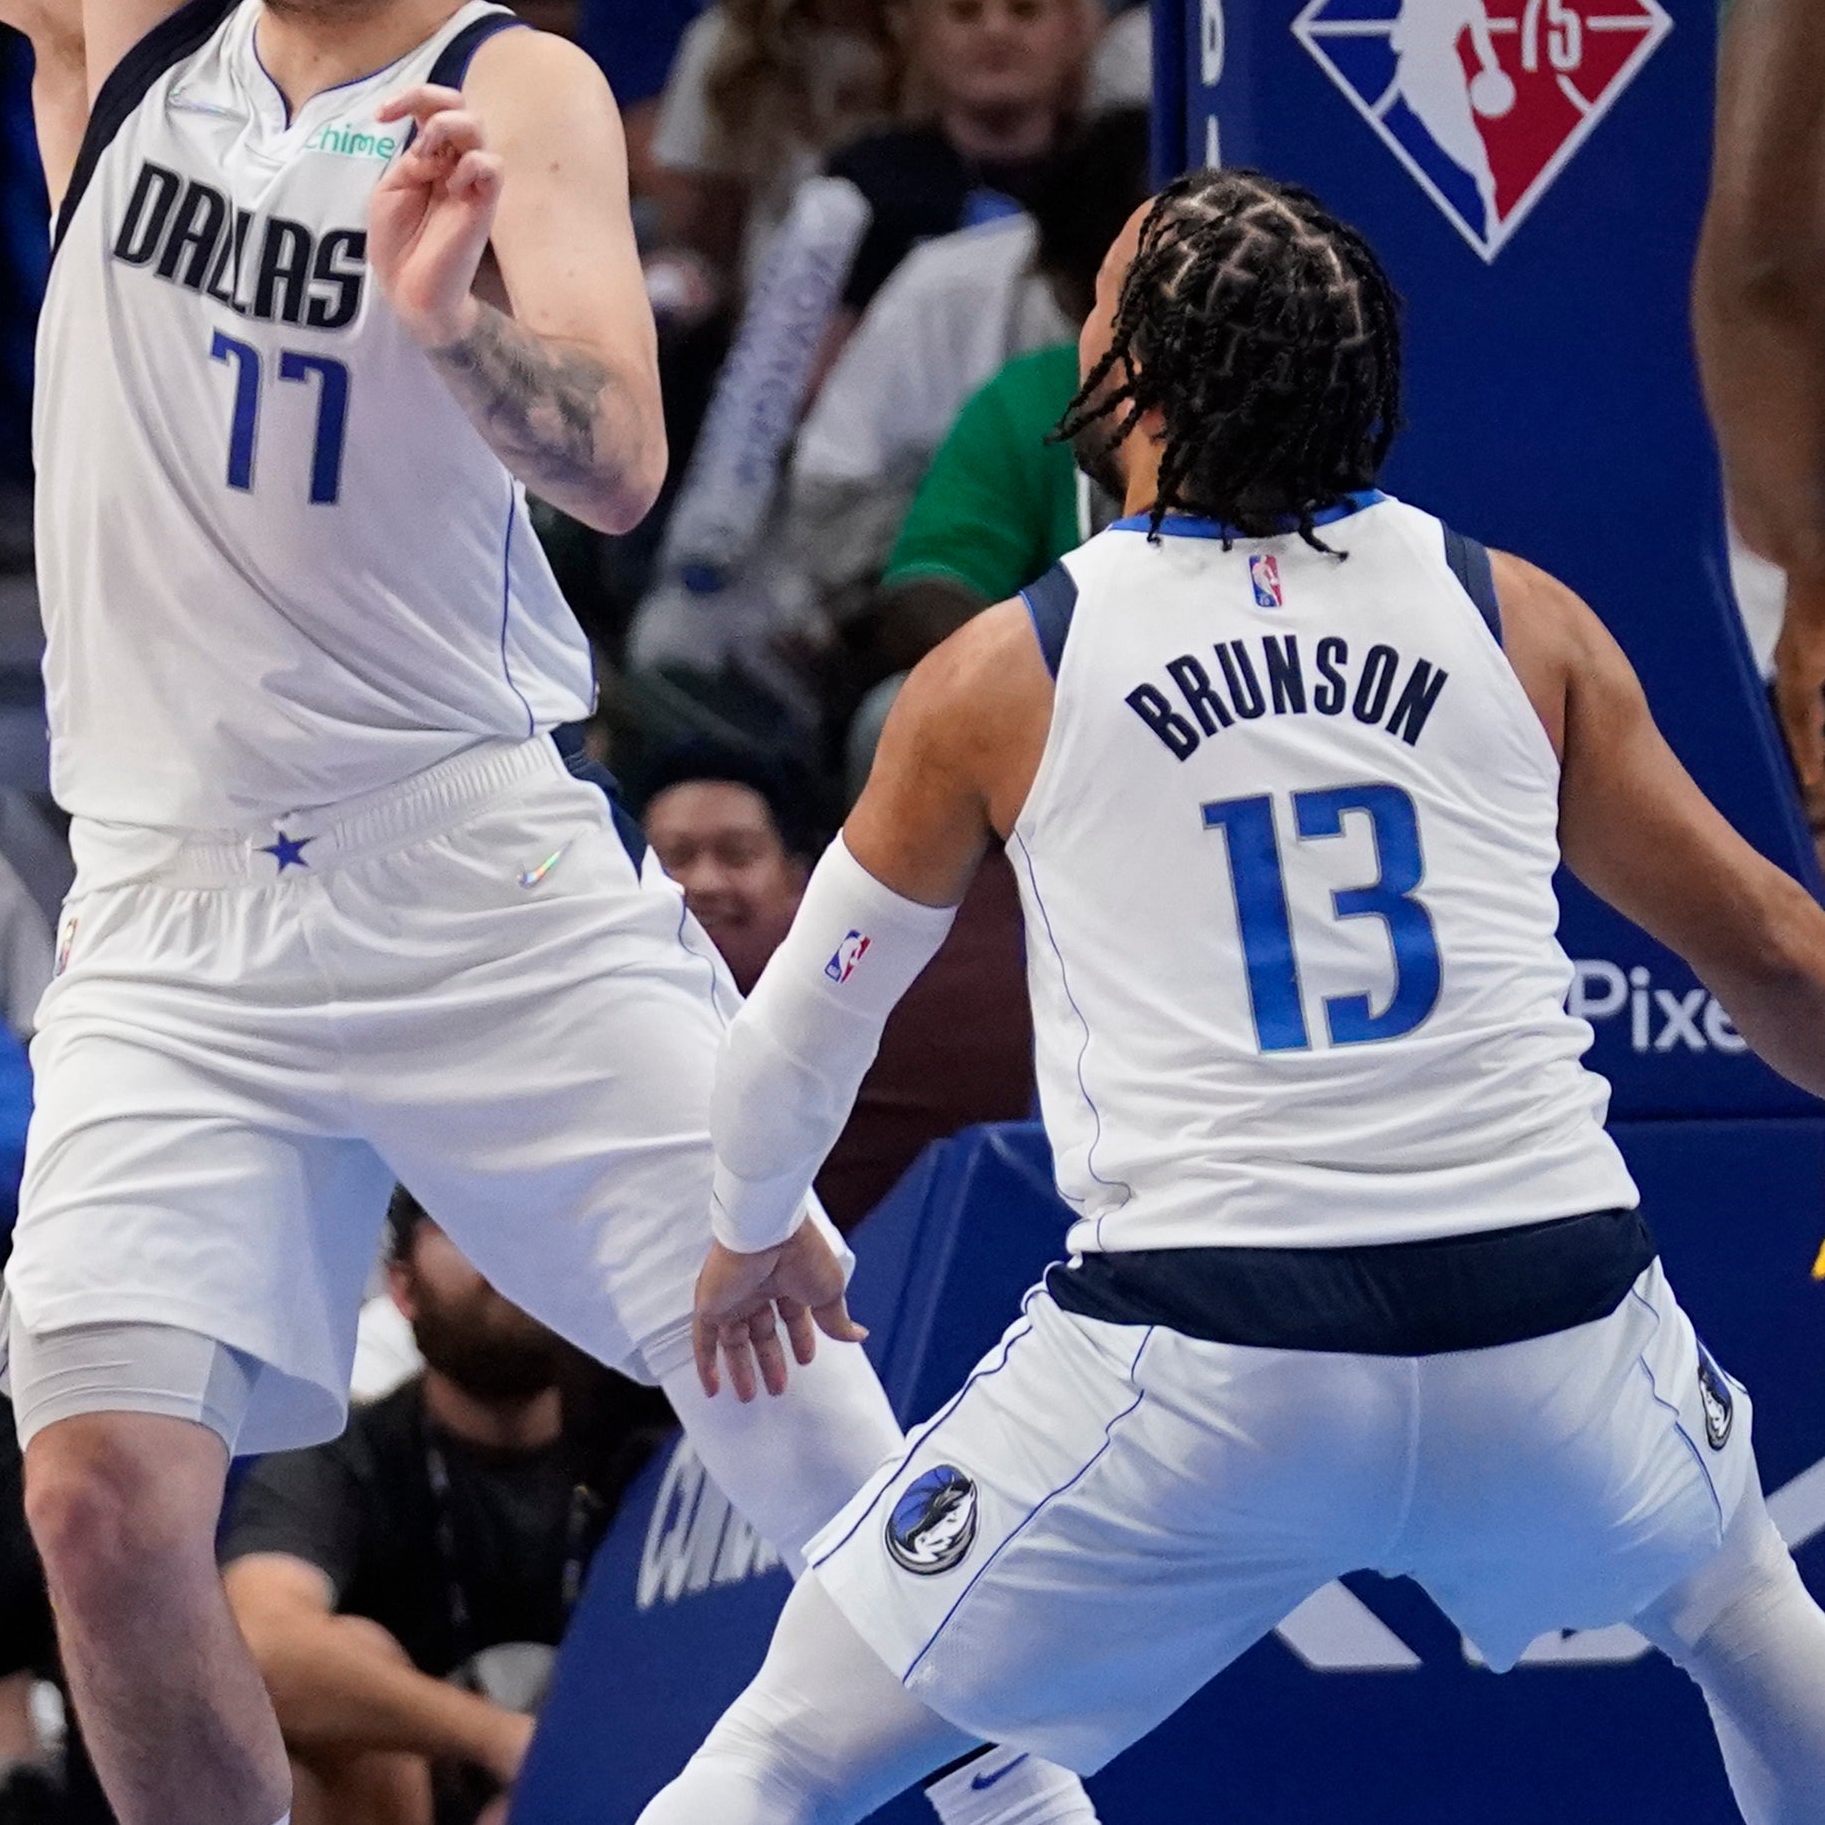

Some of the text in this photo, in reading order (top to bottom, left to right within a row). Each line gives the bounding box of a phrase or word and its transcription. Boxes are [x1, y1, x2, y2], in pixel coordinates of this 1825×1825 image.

[112, 160, 368, 330] DALLAS
[210, 328, 350, 506] 77
[1125, 634, 1449, 763] BRUNSON
[1199, 780, 1445, 1054] 13
[1565, 958, 1749, 1054] Pixe
